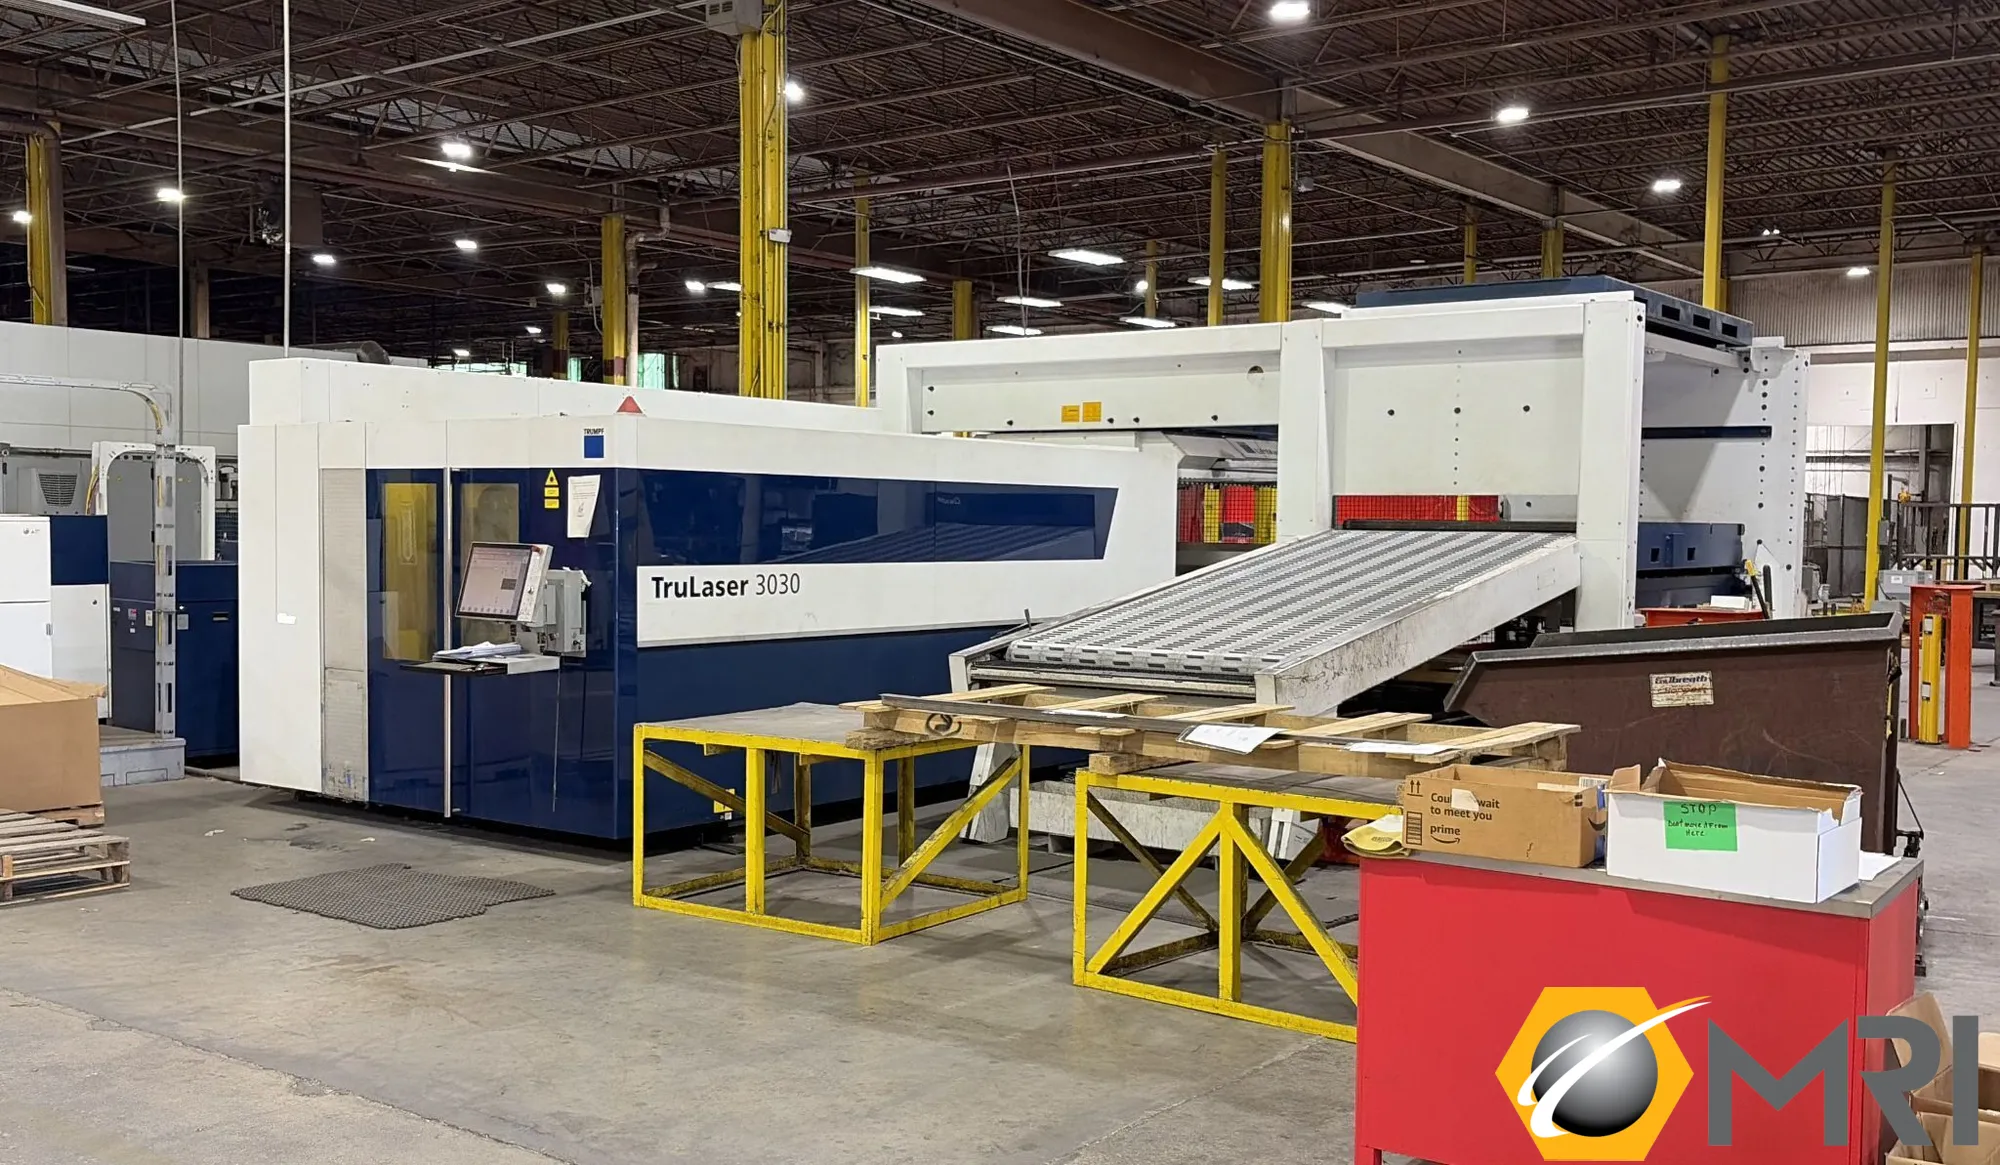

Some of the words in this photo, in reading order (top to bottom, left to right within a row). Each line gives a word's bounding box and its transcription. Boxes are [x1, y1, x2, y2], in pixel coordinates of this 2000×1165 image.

[651, 576, 749, 598] TruLaser
[755, 573, 800, 595] 3030
[1478, 799, 1500, 809] wait
[1680, 803, 1717, 815] STOP
[1430, 805, 1441, 815] to
[1444, 808, 1470, 818] meet
[1473, 810, 1492, 821] you
[1430, 824, 1461, 836] prime
